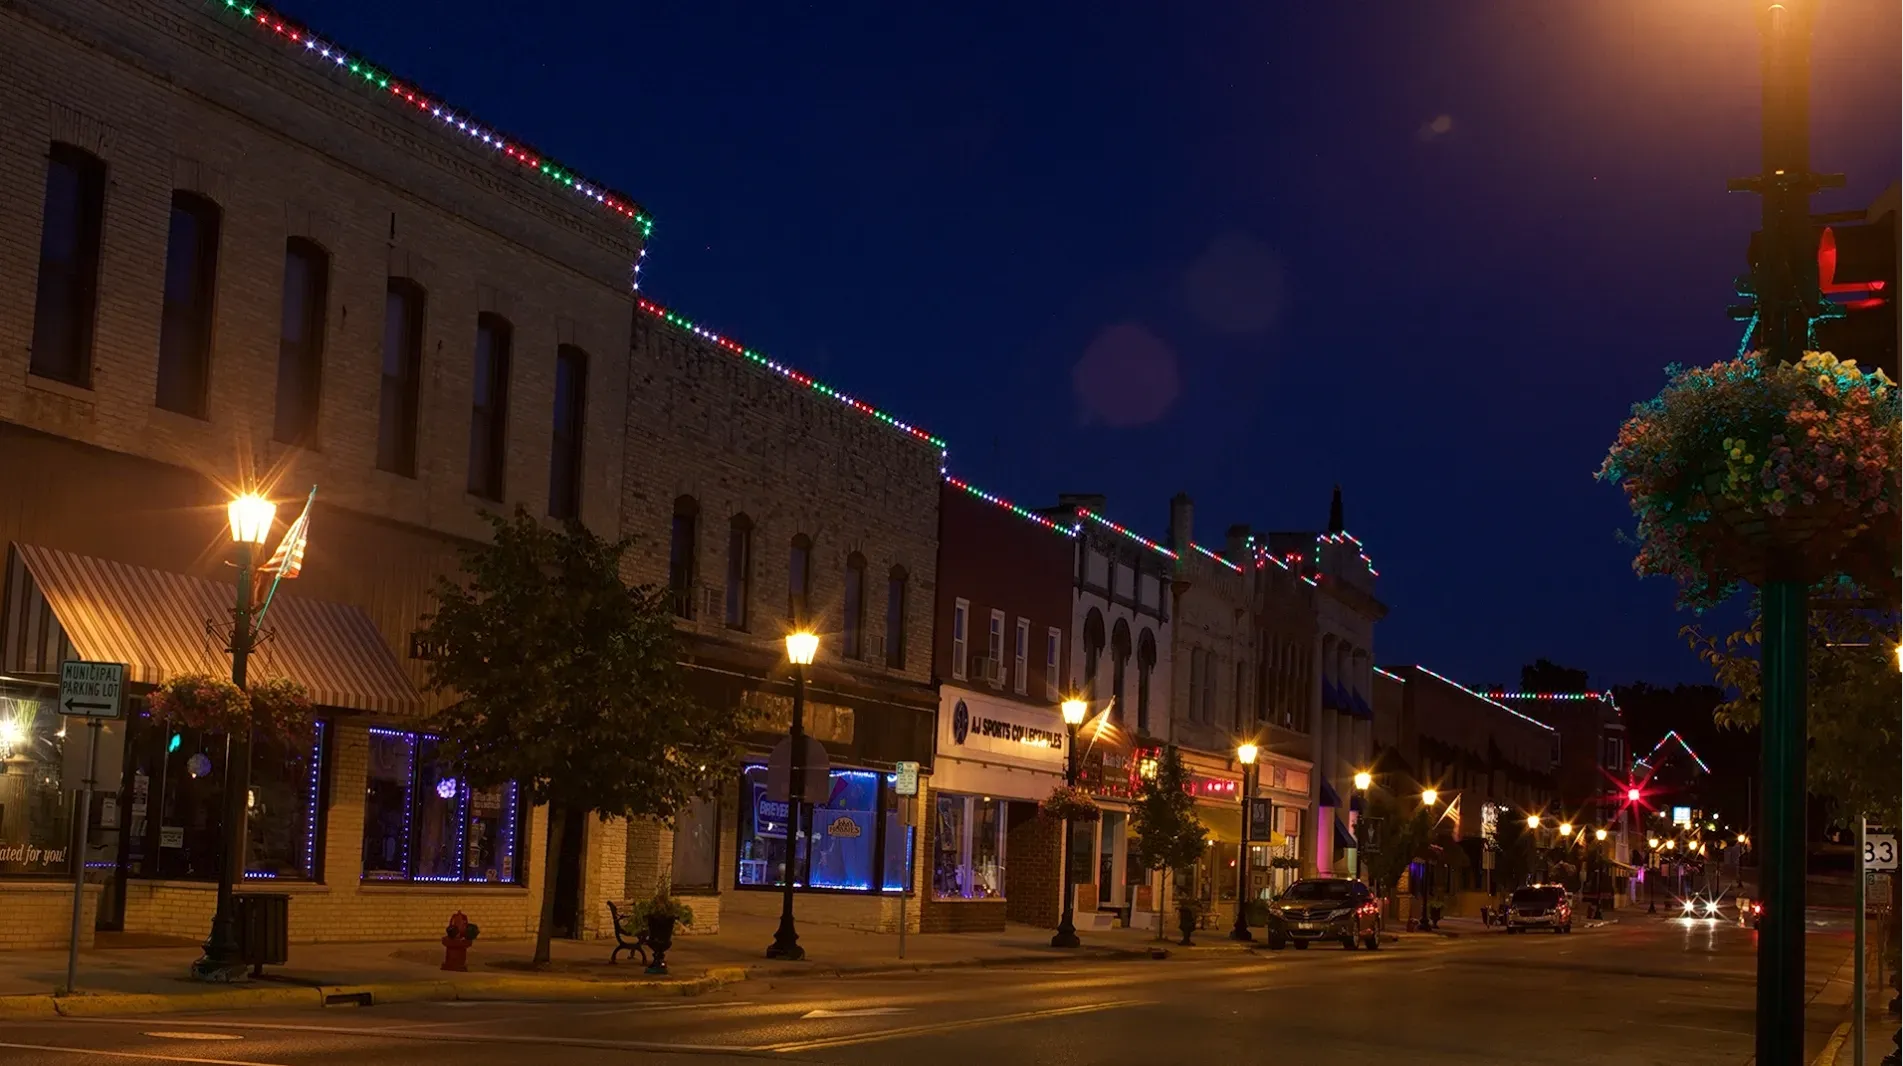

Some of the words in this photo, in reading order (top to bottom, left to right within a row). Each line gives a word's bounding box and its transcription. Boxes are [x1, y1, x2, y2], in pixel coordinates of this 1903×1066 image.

[65, 665, 118, 682] MUNICIPAL
[62, 681, 101, 697] PARKING
[102, 683, 119, 697] LOT
[971, 716, 981, 734] AJ
[982, 718, 1011, 740] SPORTS
[22, 843, 42, 867] for
[42, 845, 69, 867] you!
